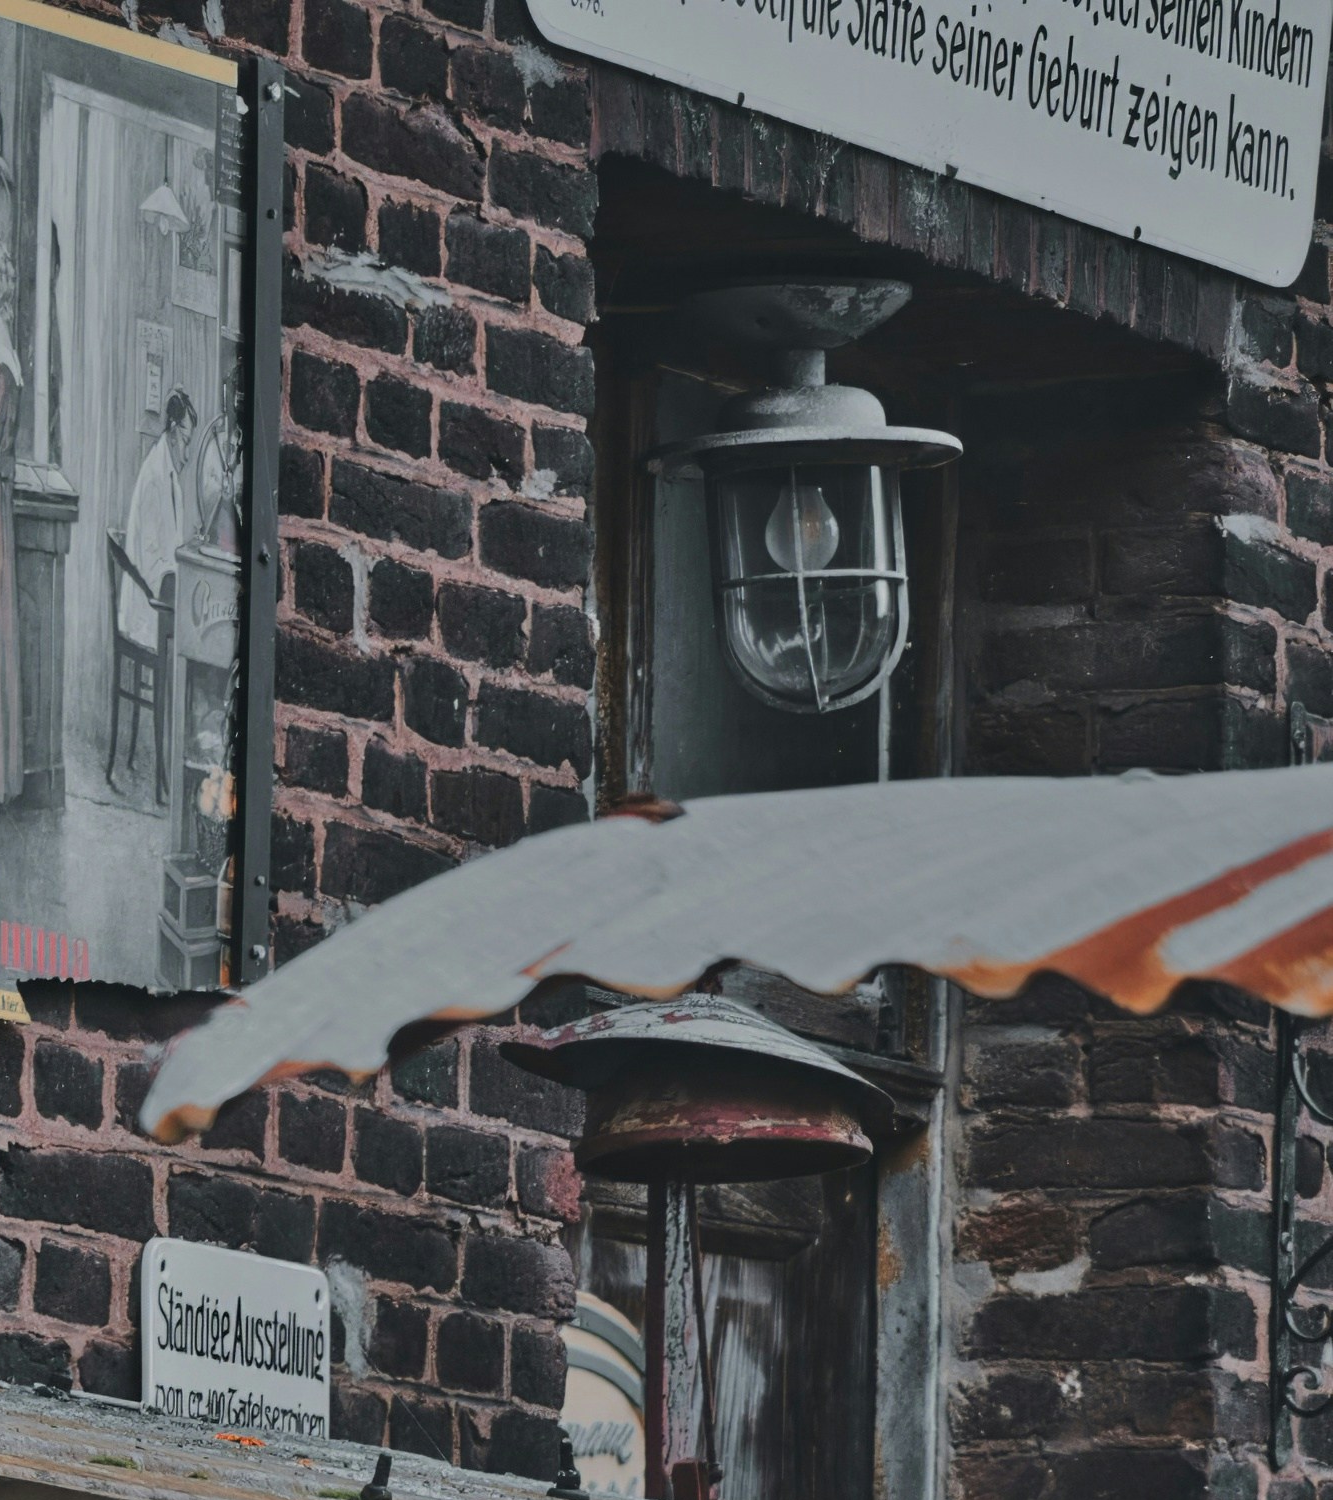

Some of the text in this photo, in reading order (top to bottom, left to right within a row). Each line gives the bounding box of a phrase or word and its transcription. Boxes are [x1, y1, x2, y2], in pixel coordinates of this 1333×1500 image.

[1227, 0, 1314, 88] Kindern
[932, 4, 1024, 101] seiner
[1028, 24, 1120, 137] Geburt
[1122, 73, 1218, 180] zeigen
[1224, 93, 1295, 201] kann.
[157, 1282, 324, 1383] Ständige Ausstellung
